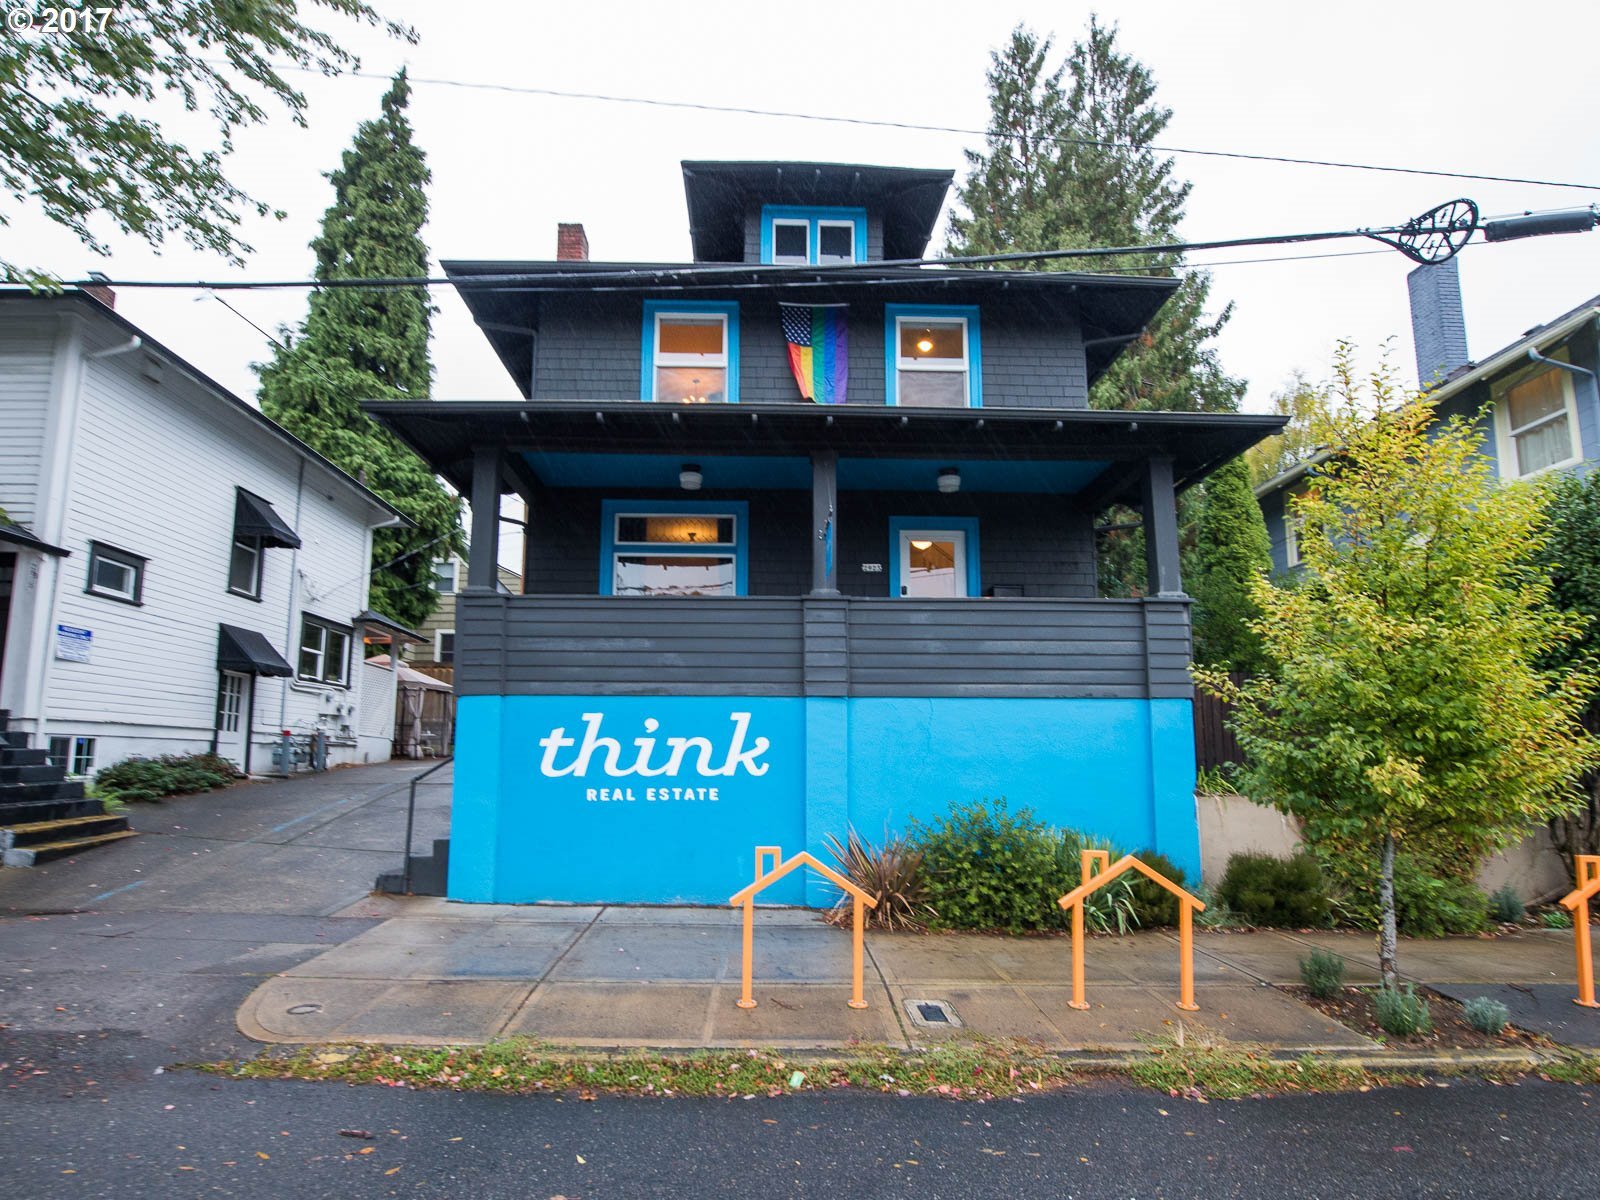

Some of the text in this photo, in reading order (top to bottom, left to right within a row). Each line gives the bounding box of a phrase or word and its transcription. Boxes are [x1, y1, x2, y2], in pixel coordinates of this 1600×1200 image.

[539, 712, 770, 777] think
[586, 788, 720, 801] REAL ESTATE
